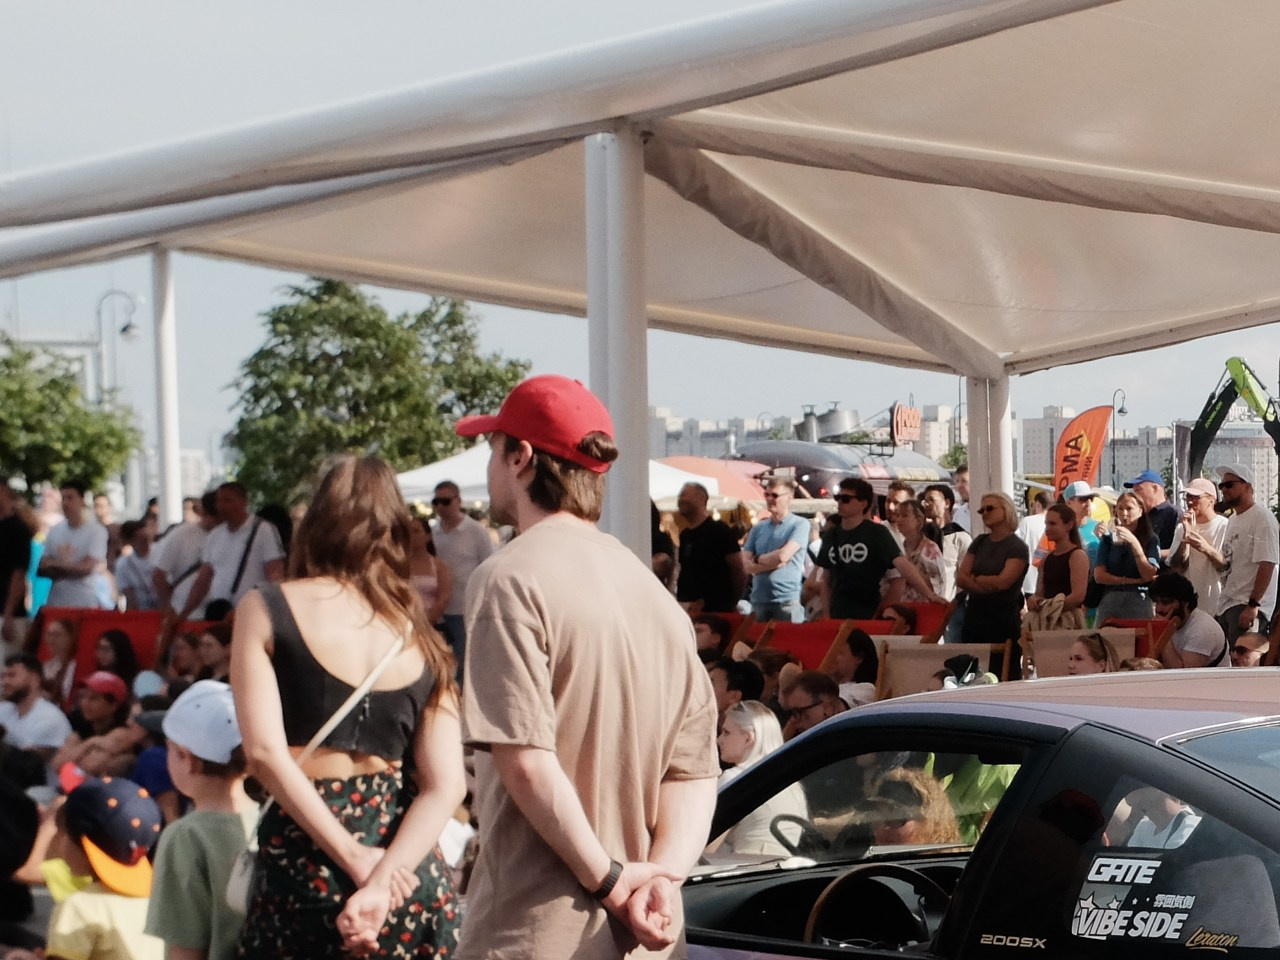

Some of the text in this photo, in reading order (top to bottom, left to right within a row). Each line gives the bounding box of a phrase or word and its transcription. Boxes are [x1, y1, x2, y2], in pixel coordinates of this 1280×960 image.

[1087, 857, 1162, 884] GATE
[1078, 907, 1189, 939] VIBE SIDE
[980, 934, 1047, 949] 200SX
